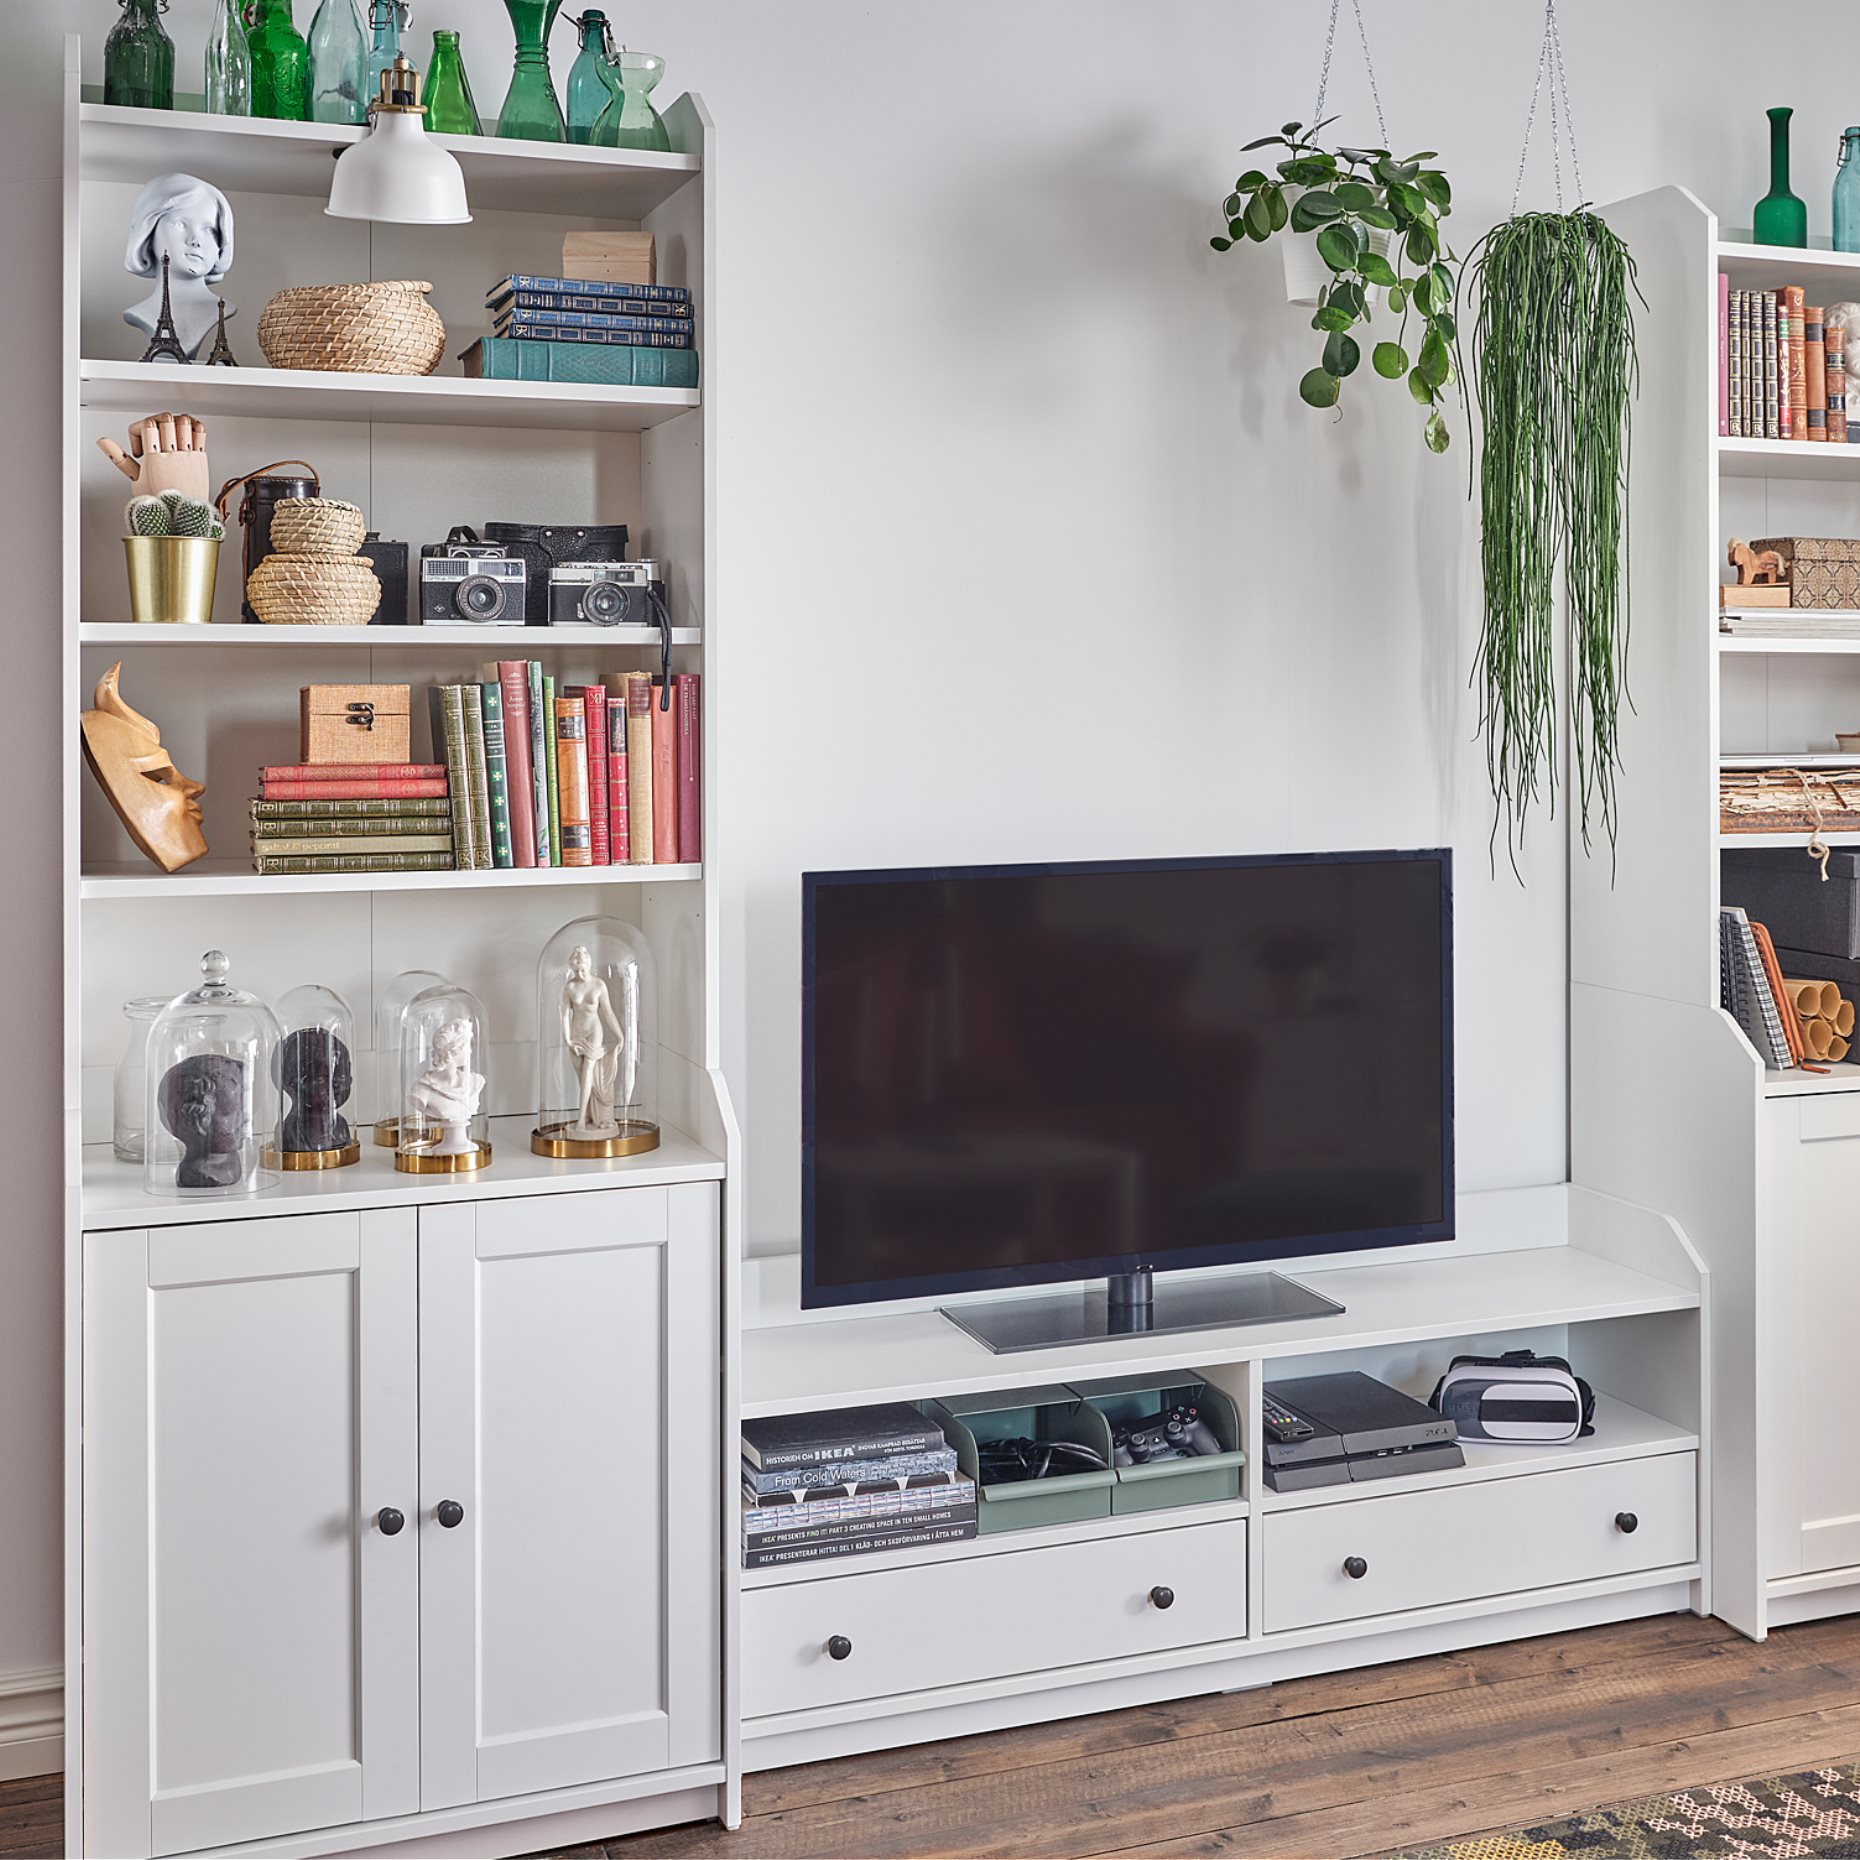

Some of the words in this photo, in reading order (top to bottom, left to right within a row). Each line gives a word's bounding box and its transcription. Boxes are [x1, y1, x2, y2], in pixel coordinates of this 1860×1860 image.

[766, 1454, 800, 1465] HISTORIEN
[814, 1447, 855, 1460] IKEA
[775, 1476, 800, 1487] From
[803, 1470, 828, 1484] Cold
[830, 1468, 866, 1481] Waters
[761, 1536, 776, 1544] IKEA
[777, 1531, 805, 1542] PRESENTS
[806, 1529, 820, 1537] FIND
[828, 1526, 843, 1534] PART
[849, 1521, 876, 1532] CREATING
[876, 1519, 893, 1528] SPACE
[894, 1517, 901, 1525] IN
[901, 1516, 913, 1524] TEN
[913, 1515, 931, 1523] SMALL
[932, 1511, 951, 1520] HOMES
[759, 1554, 775, 1563] IKEA
[775, 1548, 818, 1561] PRESENTERAR
[839, 1544, 850, 1552] DEL
[874, 1538, 887, 1547] OCH
[887, 1532, 931, 1546] SKOFÖRVARING
[935, 1529, 950, 1540] ÅTTA
[951, 1528, 965, 1537] HEM
